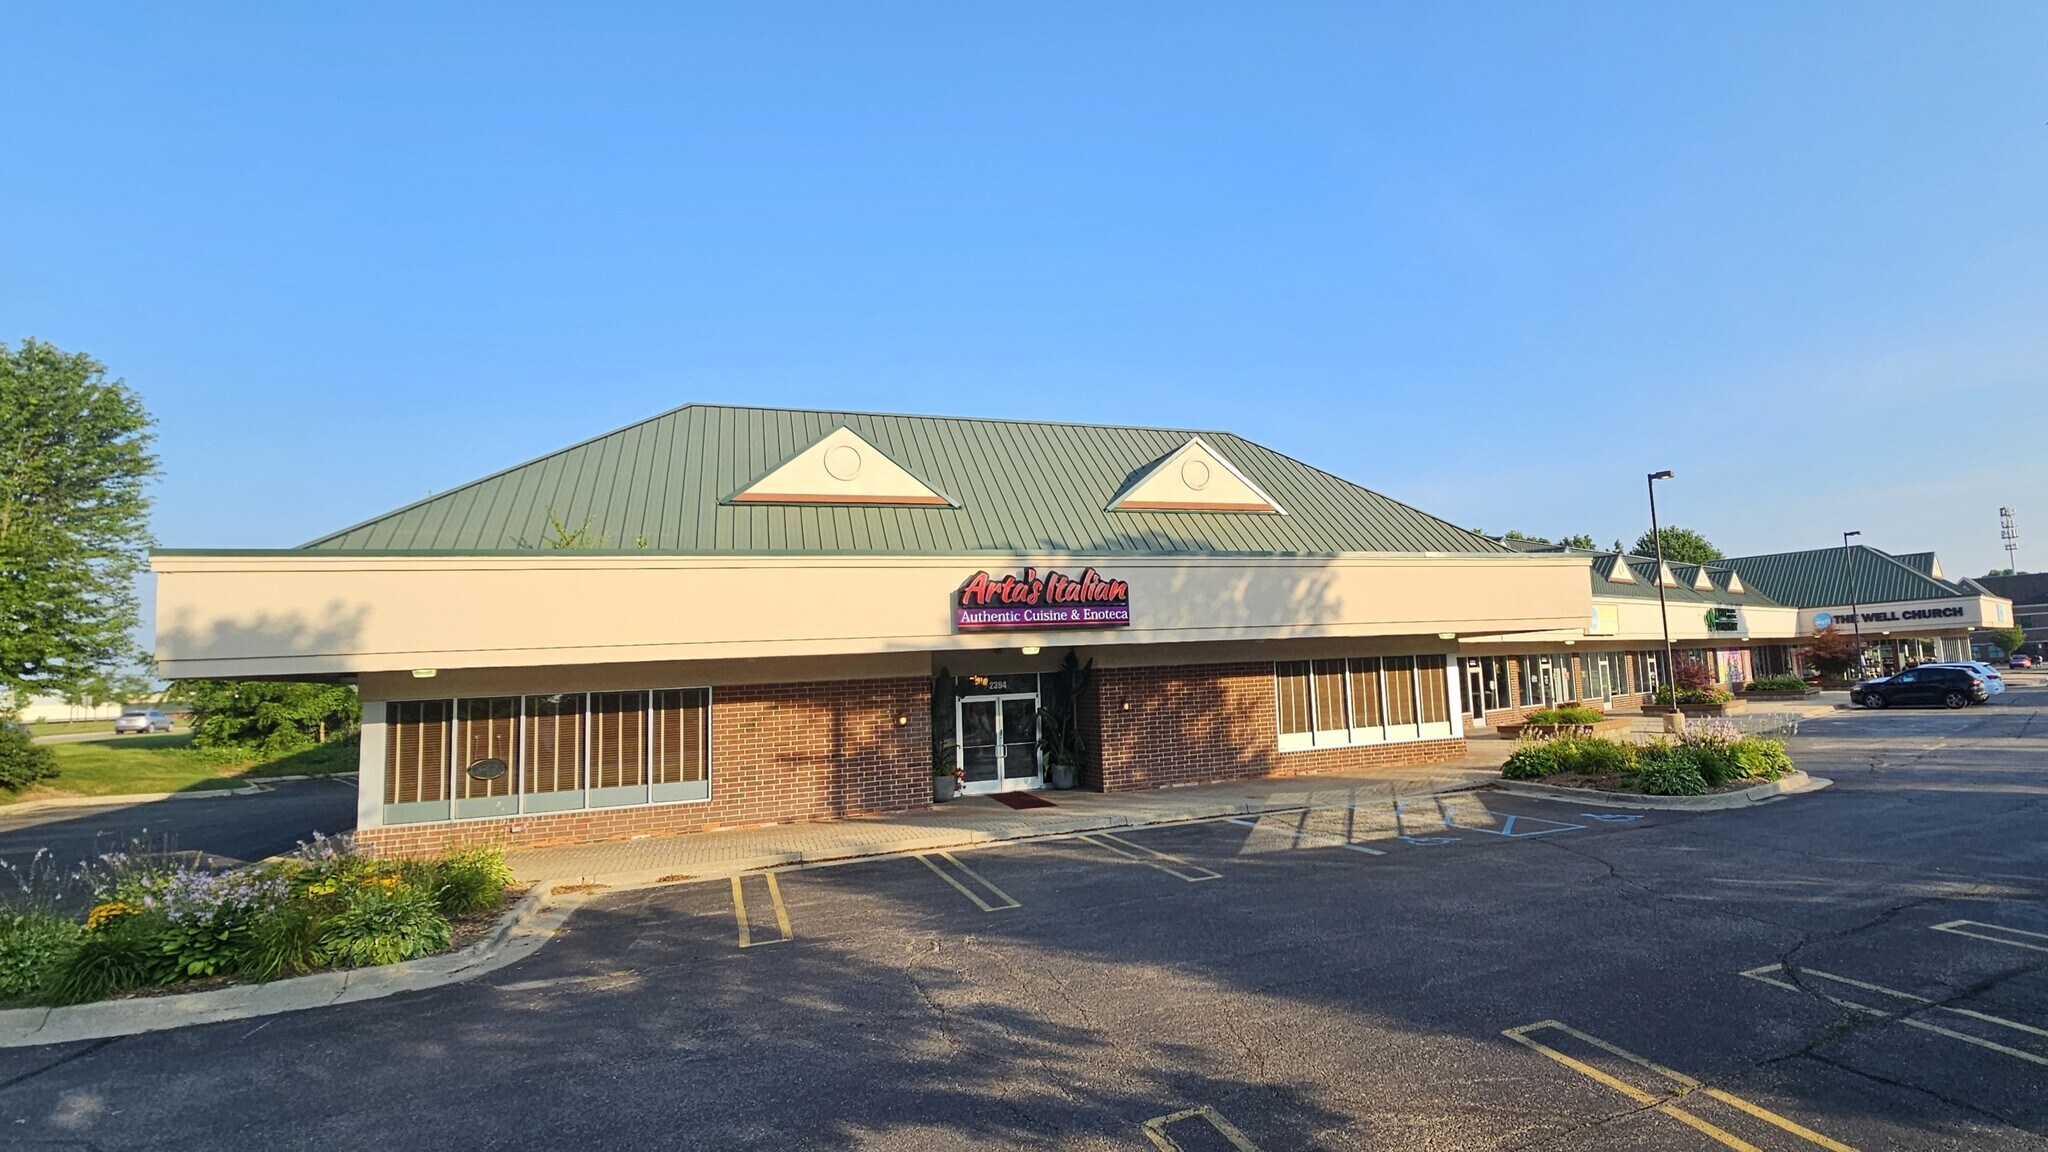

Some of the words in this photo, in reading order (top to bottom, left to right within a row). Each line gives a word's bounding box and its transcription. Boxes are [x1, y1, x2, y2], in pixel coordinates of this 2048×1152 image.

[962, 568, 1043, 605] Arta's
[1046, 567, 1127, 603] Italian
[961, 611, 1021, 623] Authentic
[1024, 610, 1067, 621] Cuisine
[1071, 609, 1080, 620] &
[1083, 608, 1129, 620] Enoteca
[1833, 615, 1859, 624] THE
[1861, 612, 1899, 622] WELL
[1902, 607, 1963, 620] CHURCH
[989, 680, 1007, 690] 2394
